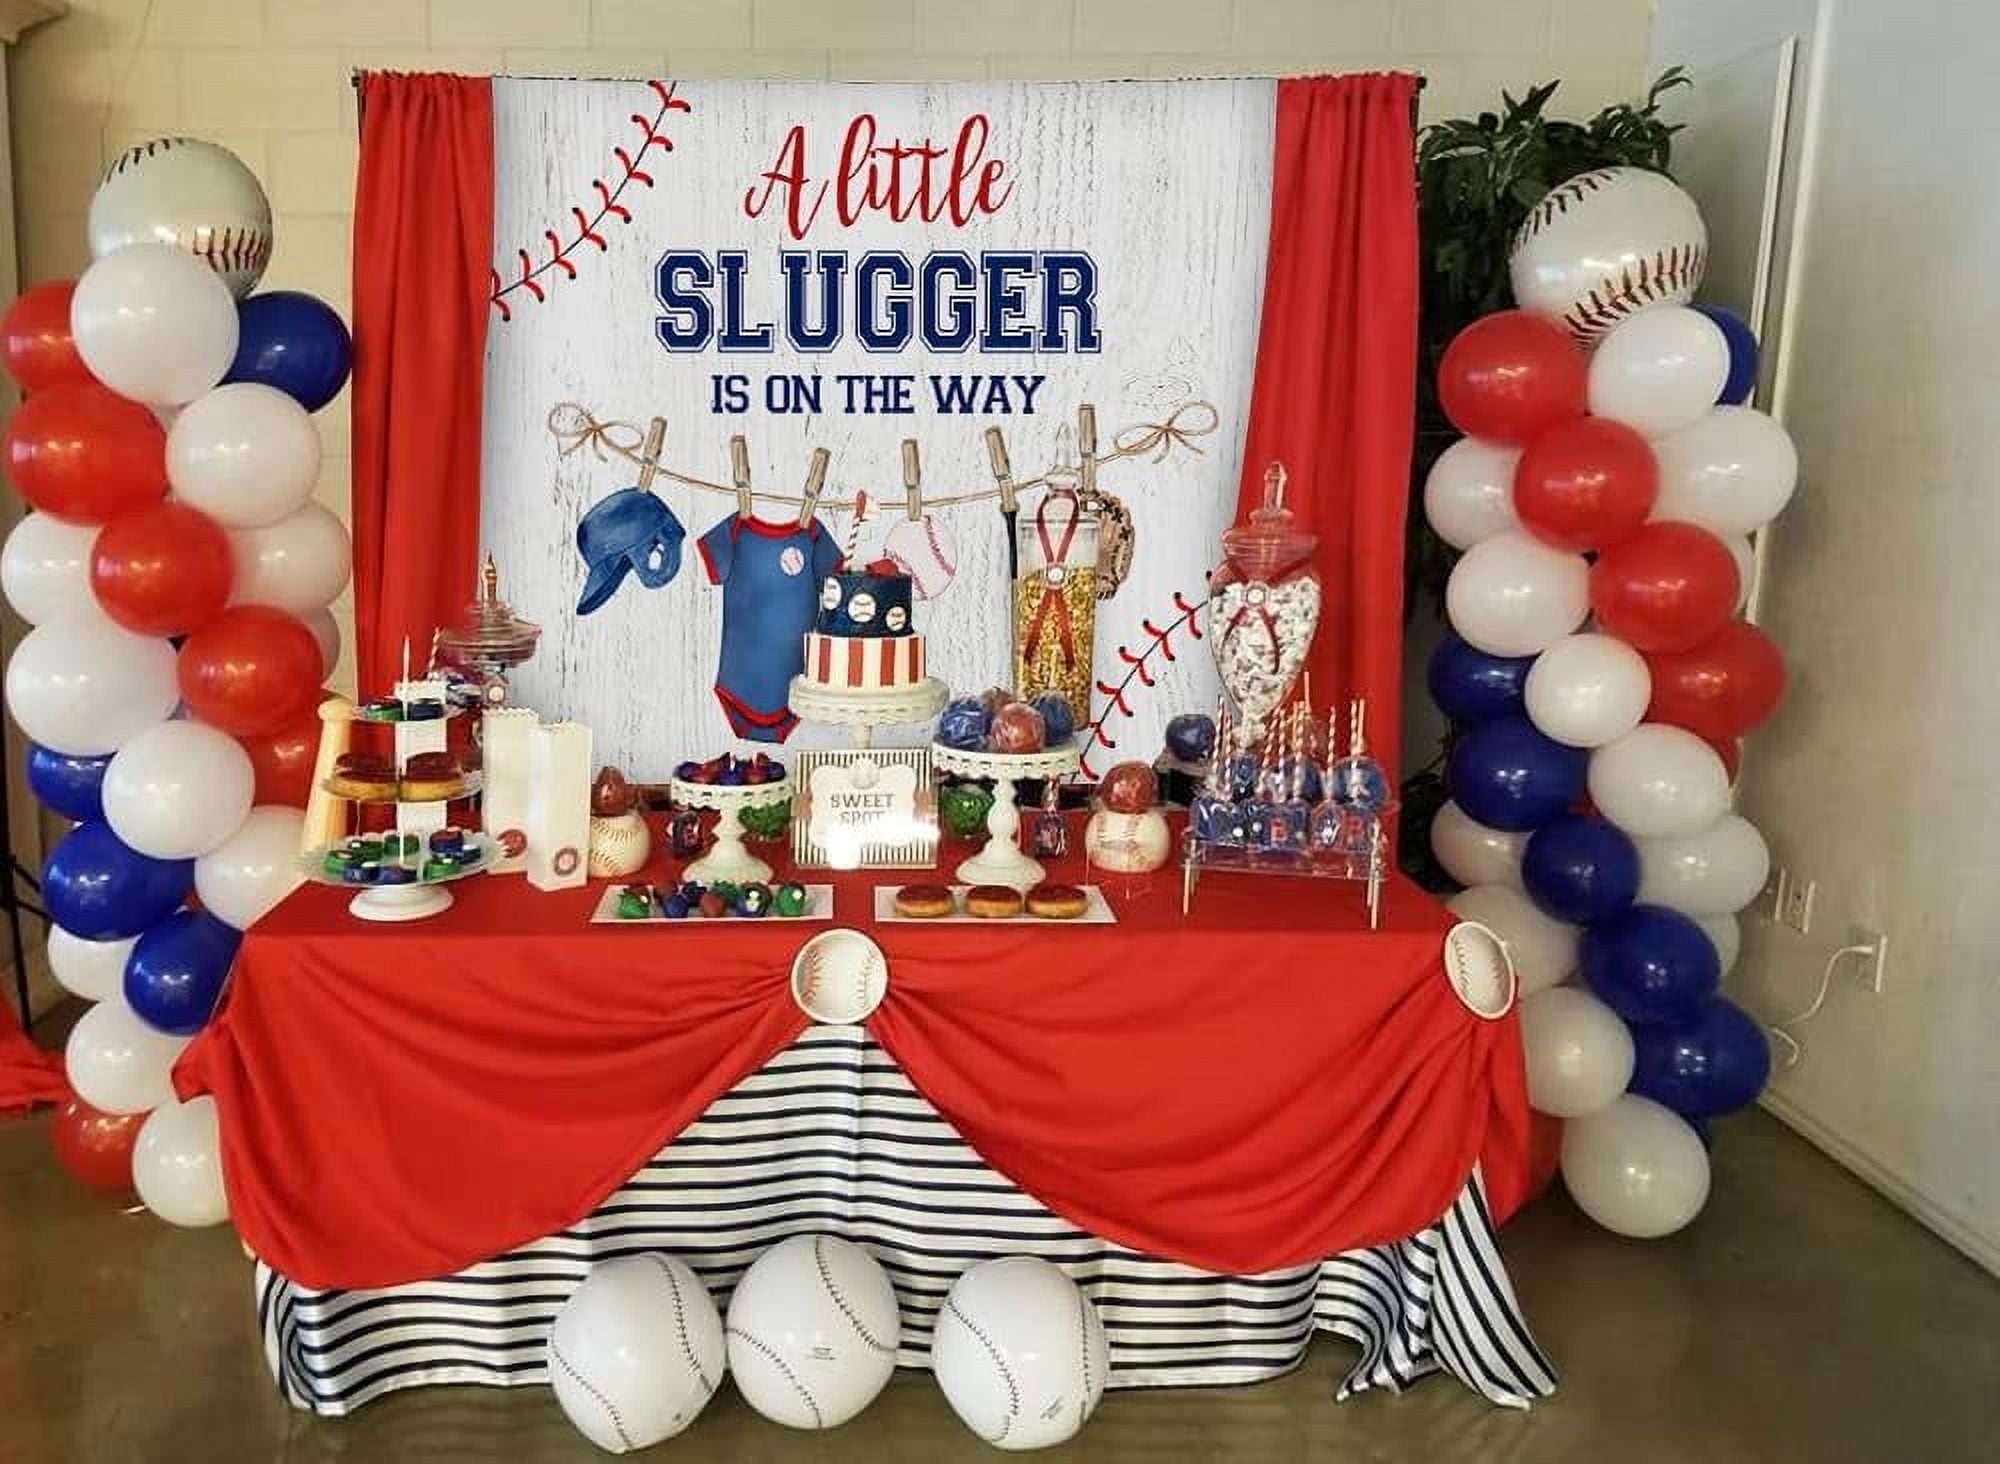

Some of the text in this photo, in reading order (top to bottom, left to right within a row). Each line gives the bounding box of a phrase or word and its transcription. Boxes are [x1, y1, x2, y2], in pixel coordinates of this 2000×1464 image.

[745, 114, 1015, 240] A little
[655, 250, 1101, 353] SLUGGER
[711, 375, 1046, 414] IS ON THE WAY
[831, 793, 896, 809] SWEET
